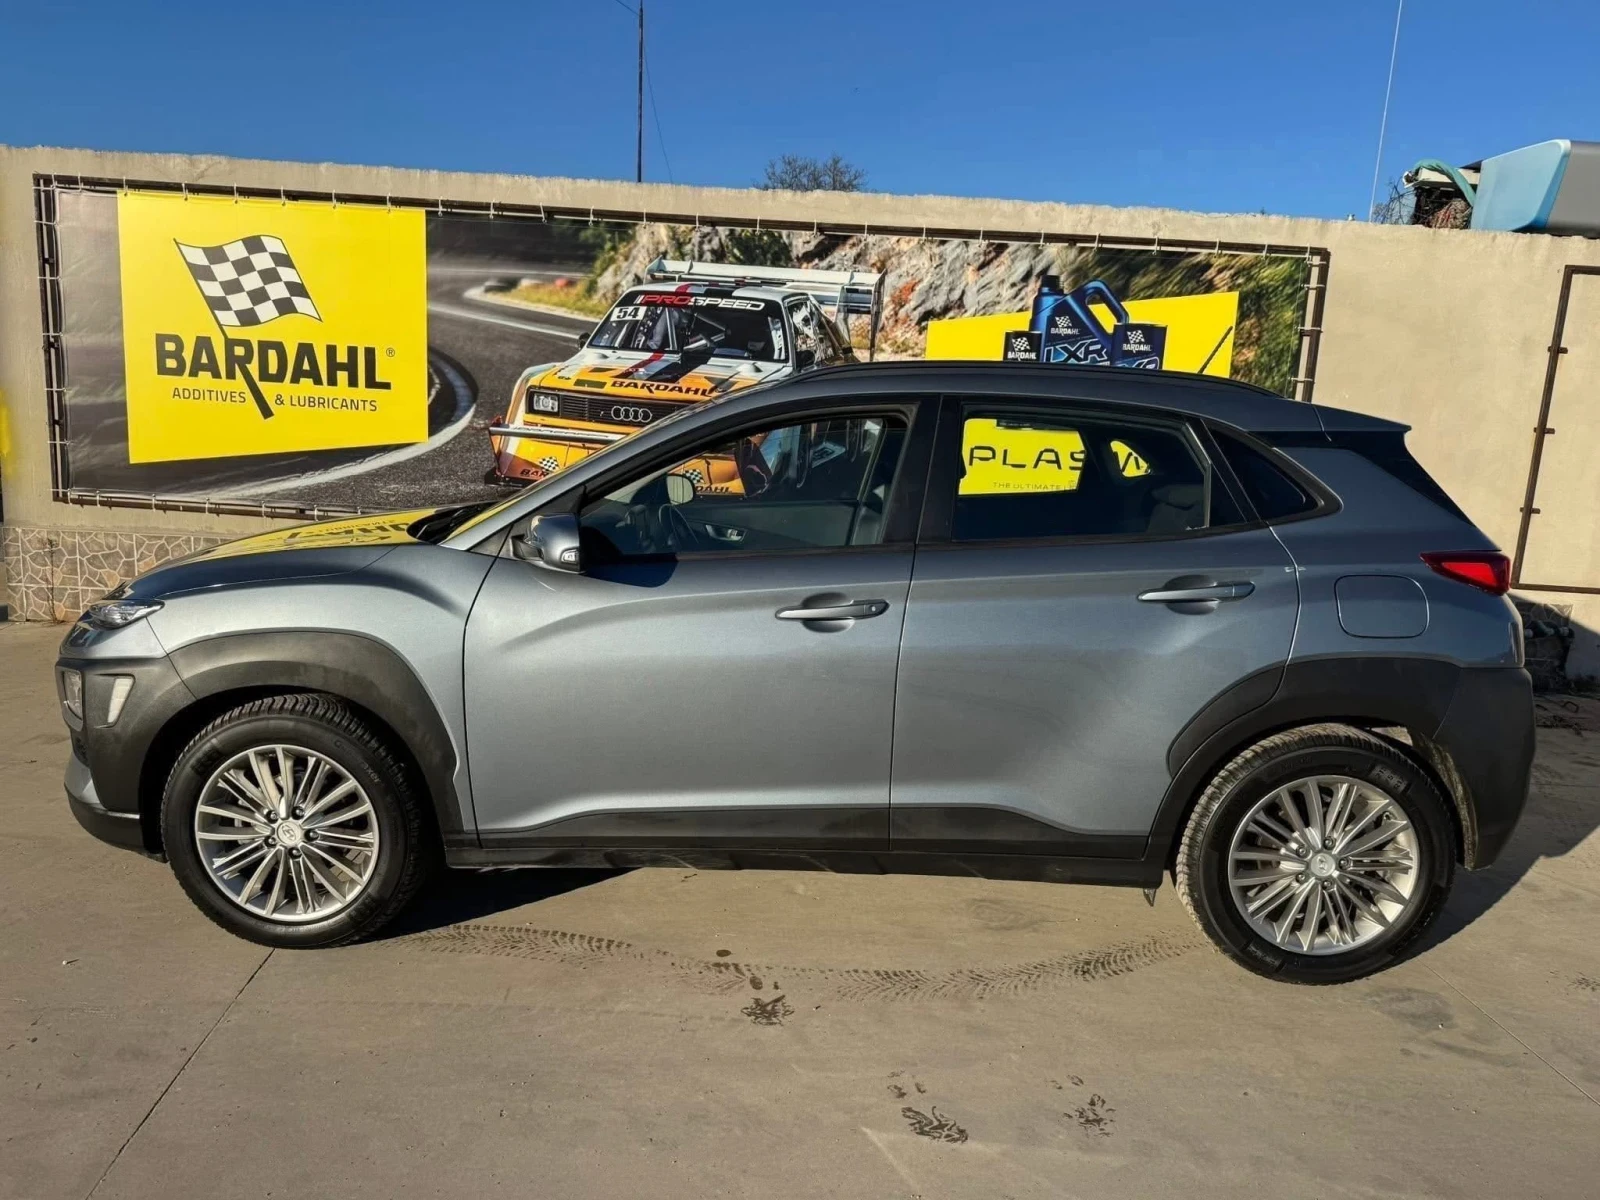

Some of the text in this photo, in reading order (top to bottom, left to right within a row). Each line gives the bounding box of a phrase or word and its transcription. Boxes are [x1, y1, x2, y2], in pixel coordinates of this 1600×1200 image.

[640, 294, 765, 311] PROSPEED
[616, 306, 640, 320] 54
[1051, 327, 1080, 337] BARDAHL
[1122, 343, 1151, 353] BARDAHL
[1007, 351, 1037, 361] BARDAHL
[610, 380, 717, 398] BARDAHL
[172, 387, 378, 412] ADDITIVES & LUBRICANTS
[993, 481, 1011, 489] THE
[1013, 482, 1062, 491] ULTIMATE
